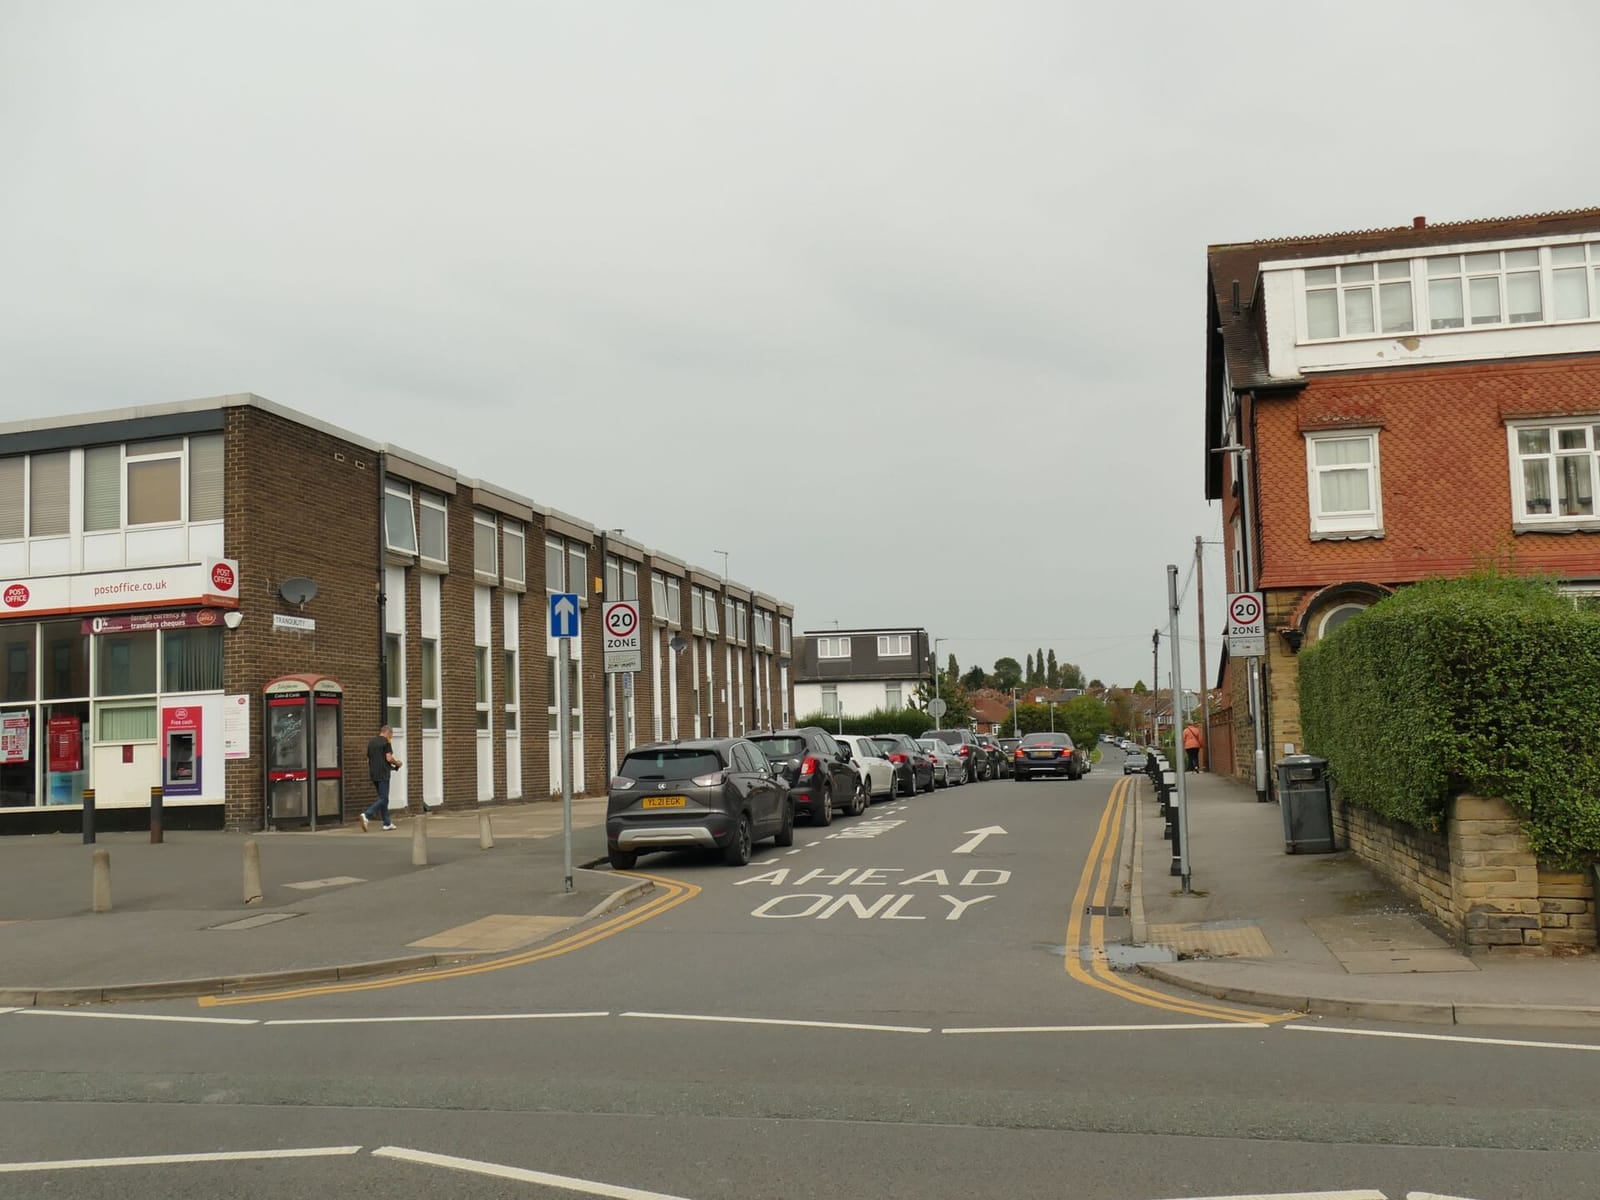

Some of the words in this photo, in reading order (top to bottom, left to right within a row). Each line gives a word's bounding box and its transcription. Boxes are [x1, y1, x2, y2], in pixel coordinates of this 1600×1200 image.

[216, 567, 231, 576] POST
[213, 575, 233, 585] OFFICE
[9, 588, 25, 596] POST
[94, 580, 167, 596] postoffice.co.uk
[6, 595, 28, 603] OFFICE
[1235, 604, 1256, 616] 20
[153, 612, 179, 620] currency
[611, 613, 632, 627] 20
[131, 621, 159, 630] travellers
[160, 620, 186, 629] cheques
[1232, 626, 1261, 635] ZONE
[607, 638, 637, 648] ZONE
[666, 798, 681, 806] EGK
[732, 868, 1012, 886] AHEAD
[750, 893, 997, 920] ONLY
